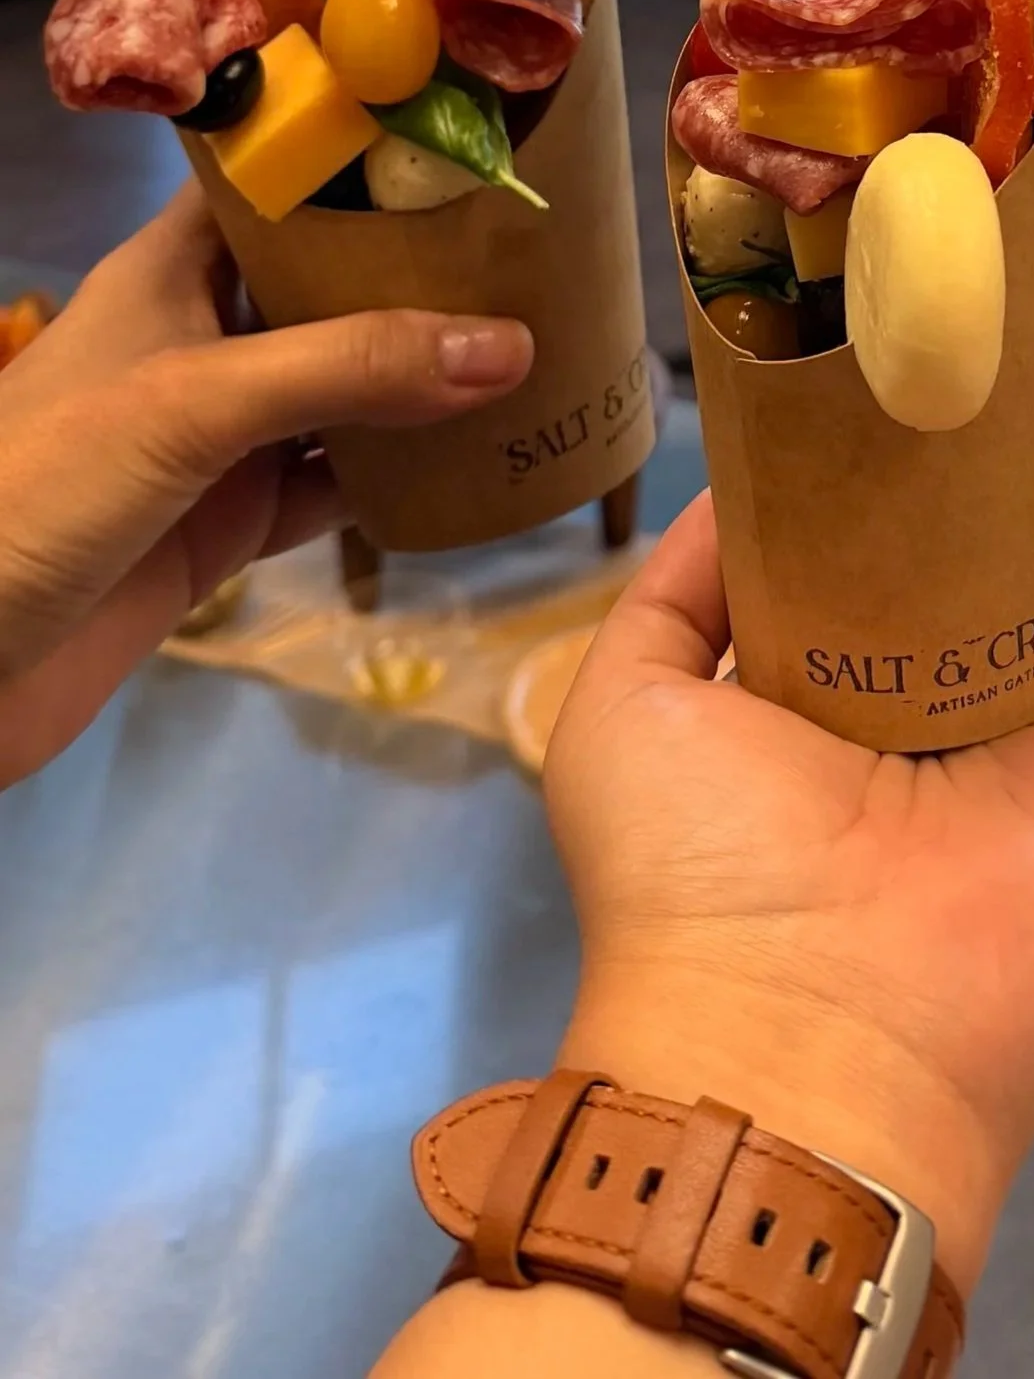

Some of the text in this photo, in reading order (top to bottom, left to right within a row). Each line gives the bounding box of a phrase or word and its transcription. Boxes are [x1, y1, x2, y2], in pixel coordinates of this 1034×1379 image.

[506, 403, 590, 474] SALT
[603, 384, 623, 421] &
[805, 647, 914, 695] SALT
[933, 649, 970, 688] &
[926, 685, 999, 716] ARTISAN
